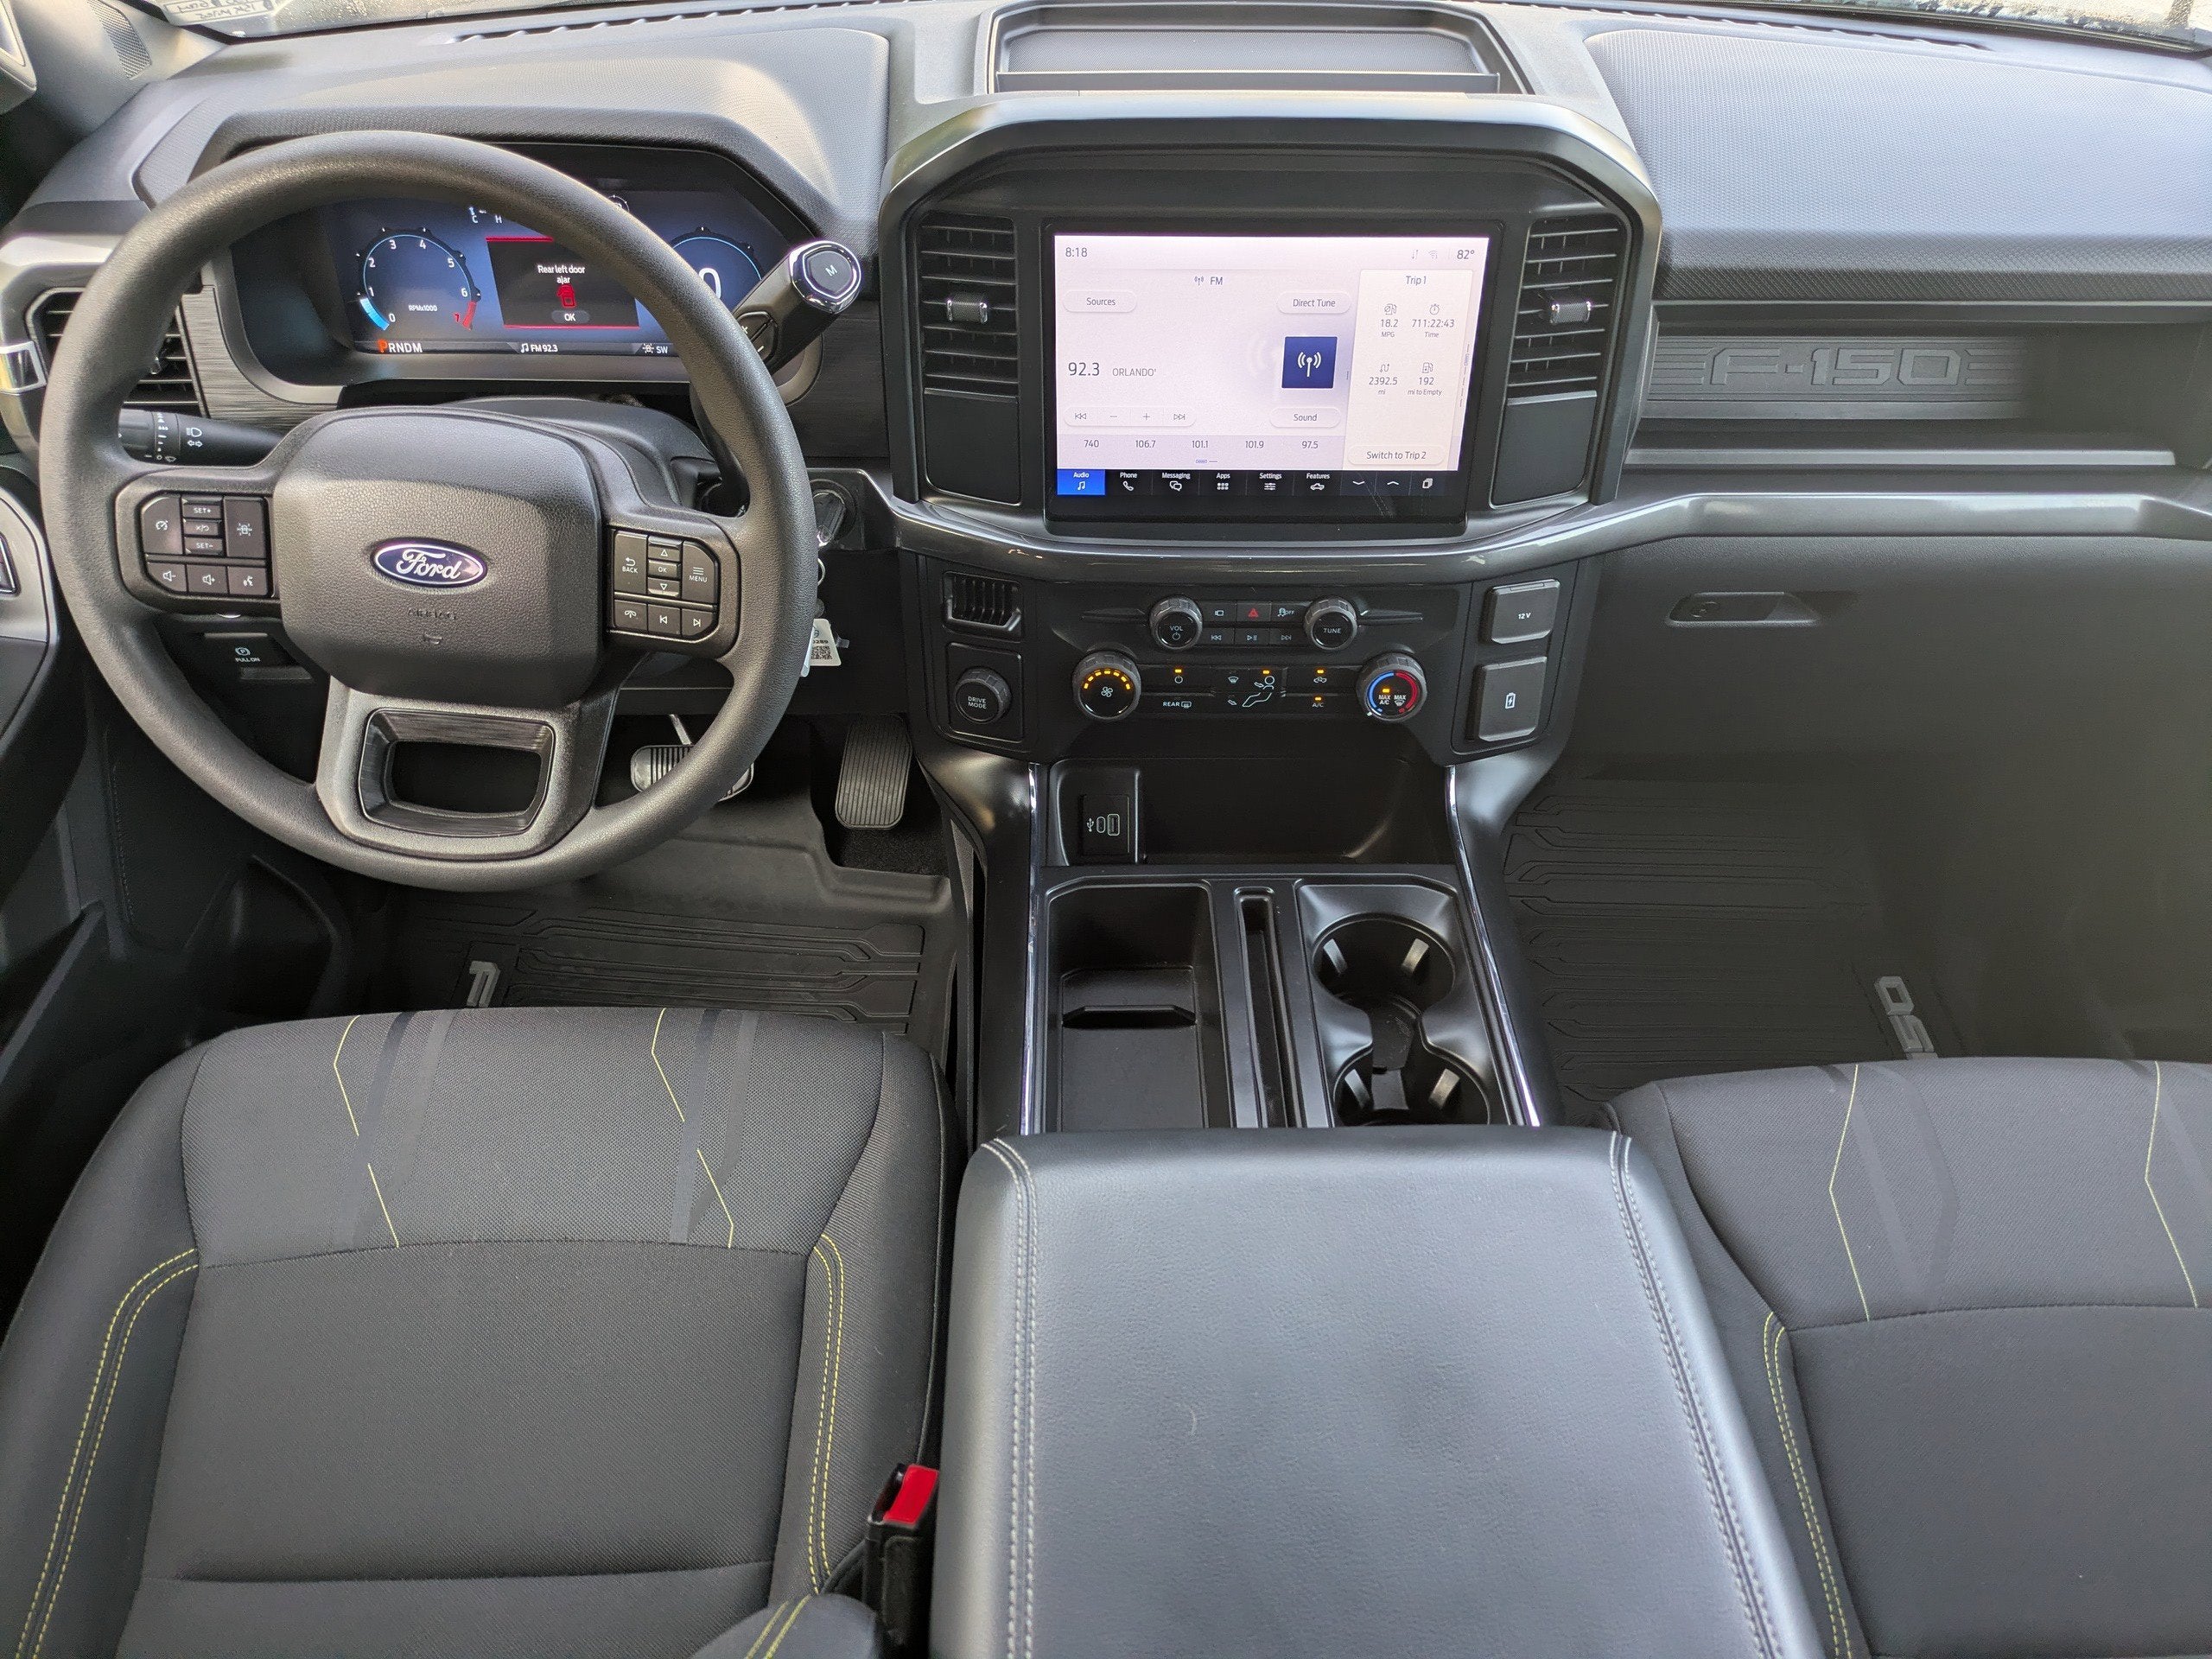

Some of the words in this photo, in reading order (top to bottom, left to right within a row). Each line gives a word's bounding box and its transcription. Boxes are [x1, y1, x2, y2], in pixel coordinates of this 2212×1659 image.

[495, 215, 503, 224] H
[389, 239, 397, 250] 3
[419, 239, 427, 250] 4
[1065, 247, 1088, 257] 8:18
[1456, 249, 1475, 260] 82°
[368, 257, 376, 268] 2
[448, 258, 454, 268] 5
[537, 264, 555, 274] Rear
[555, 264, 568, 274] left
[569, 264, 586, 274] door
[825, 264, 838, 277] M
[556, 276, 571, 286] ajar
[1210, 276, 1224, 286] FM
[1406, 276, 1421, 286] Trip
[369, 286, 375, 297] 1
[461, 288, 468, 297] 6
[1086, 297, 1116, 307] Sources
[1293, 298, 1315, 308] Direct
[1317, 298, 1336, 308] Tune
[388, 313, 396, 323] 0
[454, 314, 460, 322] 7
[563, 313, 576, 322] OK
[1381, 319, 1399, 328] 18.2
[1411, 319, 1455, 328] 711:22:43
[531, 344, 543, 353] FM
[543, 344, 559, 353] 92.3
[656, 346, 669, 354] SW
[1067, 362, 1101, 377] 92.3
[1709, 347, 1962, 386] F-150
[1369, 377, 1398, 386] 2392.5
[1418, 377, 1434, 386] 192
[1423, 389, 1443, 397] Empty
[1294, 413, 1318, 423] Sound
[1084, 439, 1100, 448] 740
[1135, 439, 1157, 448] 106.7
[1192, 440, 1209, 448] 101.1
[1245, 440, 1264, 449] 101.9
[1302, 440, 1319, 449] 97.5
[1366, 451, 1394, 461] Switch
[1395, 451, 1403, 460] to
[1405, 451, 1421, 461] Trip
[1421, 451, 1427, 460] 2
[1161, 472, 1191, 481] Messaging
[1216, 472, 1230, 481] Apps
[1259, 472, 1282, 481] Settings
[396, 549, 462, 580] Ford
